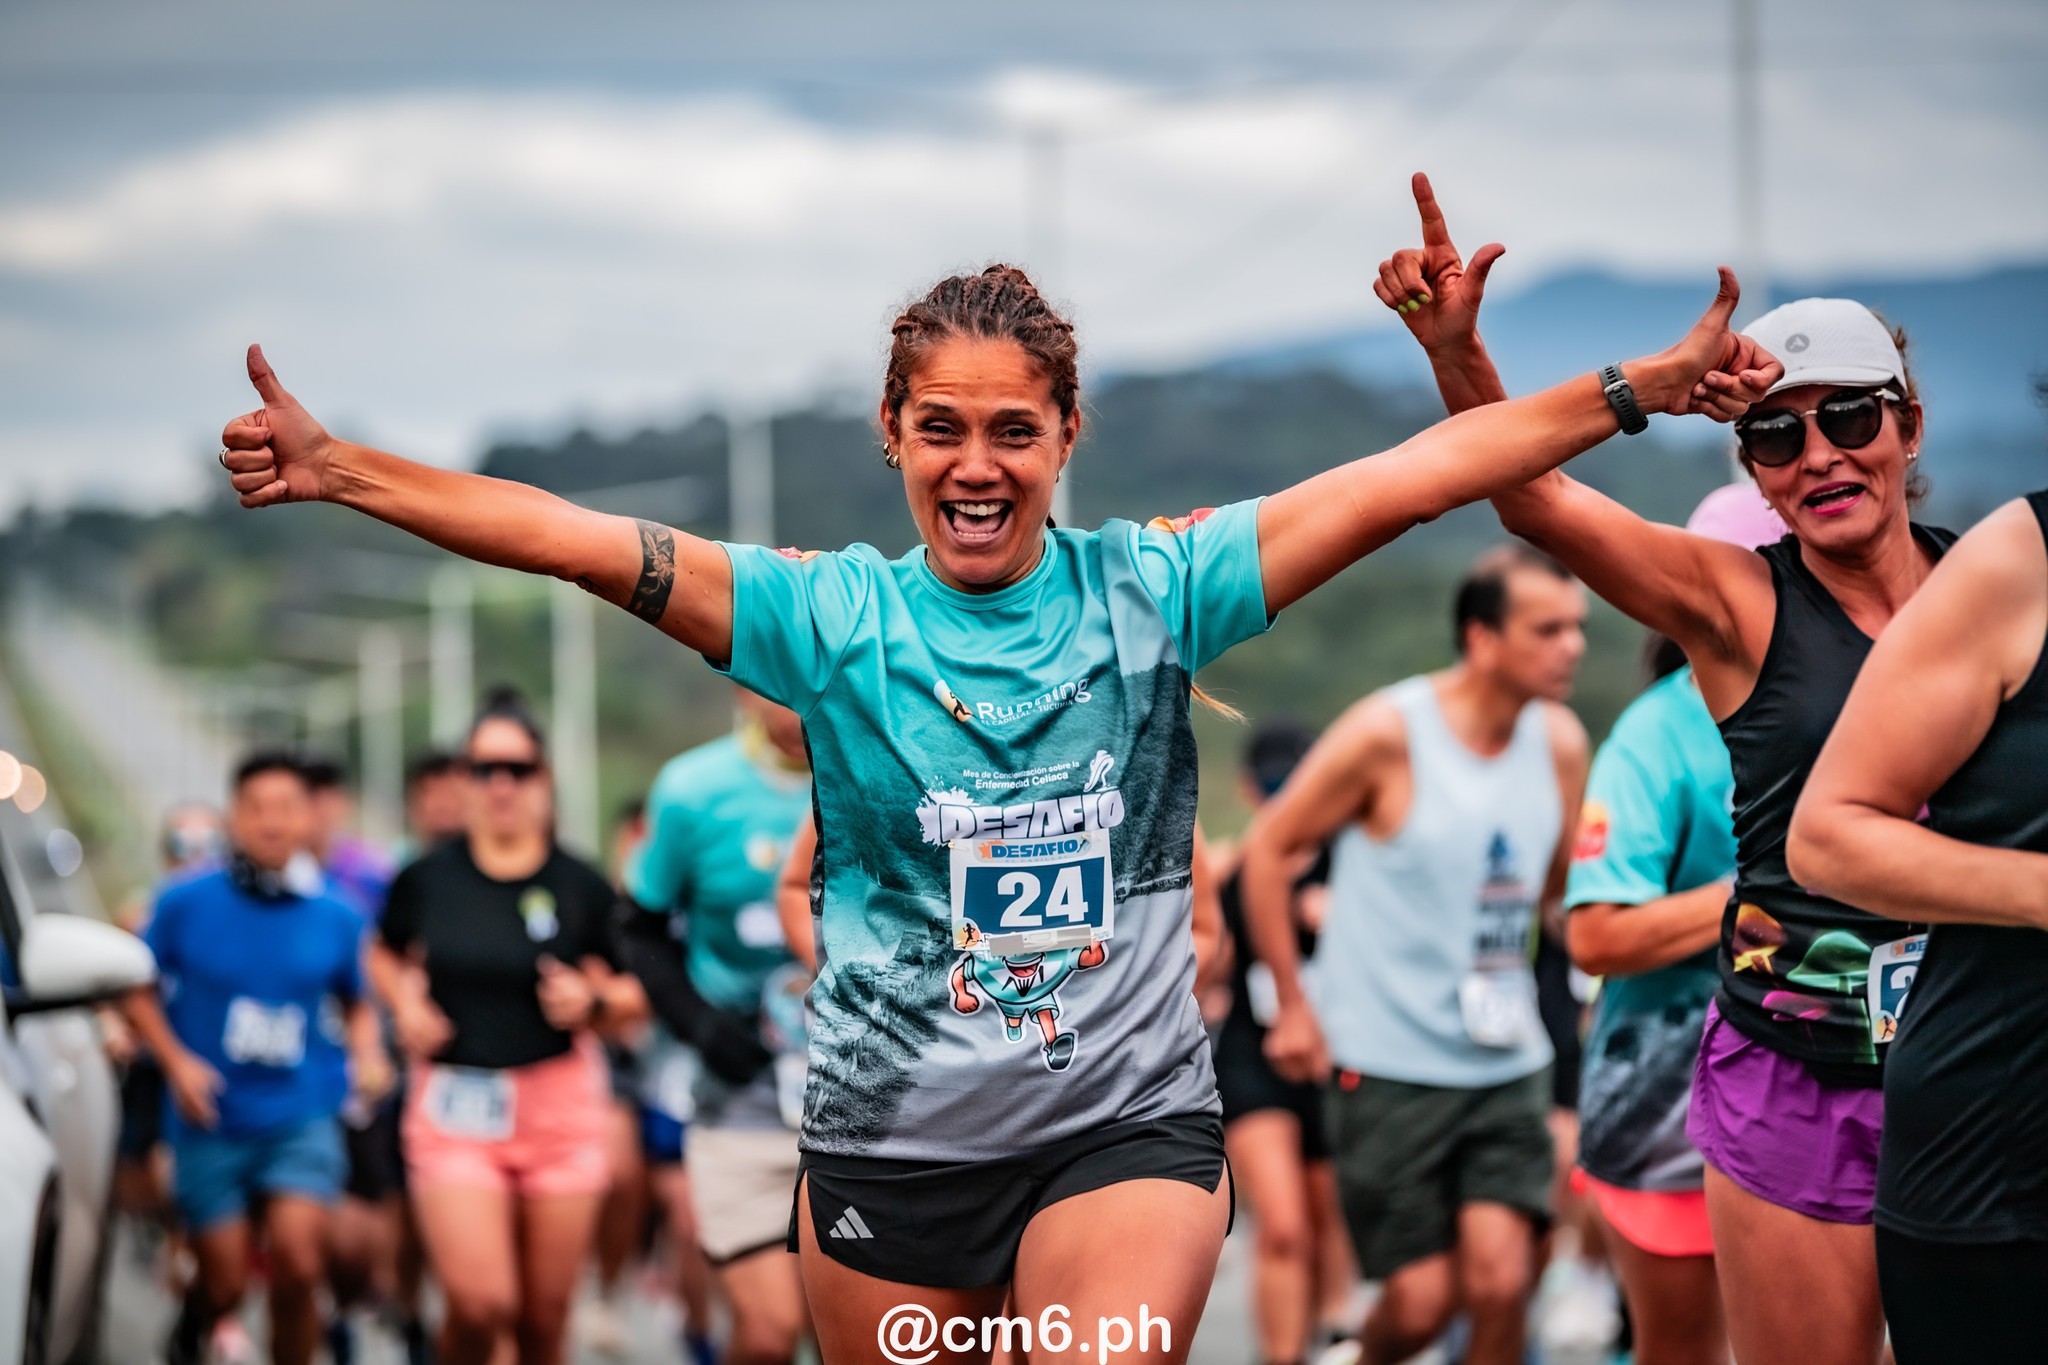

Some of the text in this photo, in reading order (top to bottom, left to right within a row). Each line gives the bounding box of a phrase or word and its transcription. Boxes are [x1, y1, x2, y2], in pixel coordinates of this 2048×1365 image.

[976, 678, 1092, 720] Running
[992, 710, 1031, 726] CADILLAL
[963, 769, 979, 778] Mes
[981, 770, 992, 779] de
[1049, 763, 1071, 773] sobre
[975, 778, 1030, 789] Enfermedad
[939, 790, 1125, 843] DESAFIO
[991, 839, 1079, 858] DESAFIO
[997, 865, 1089, 928] 24
